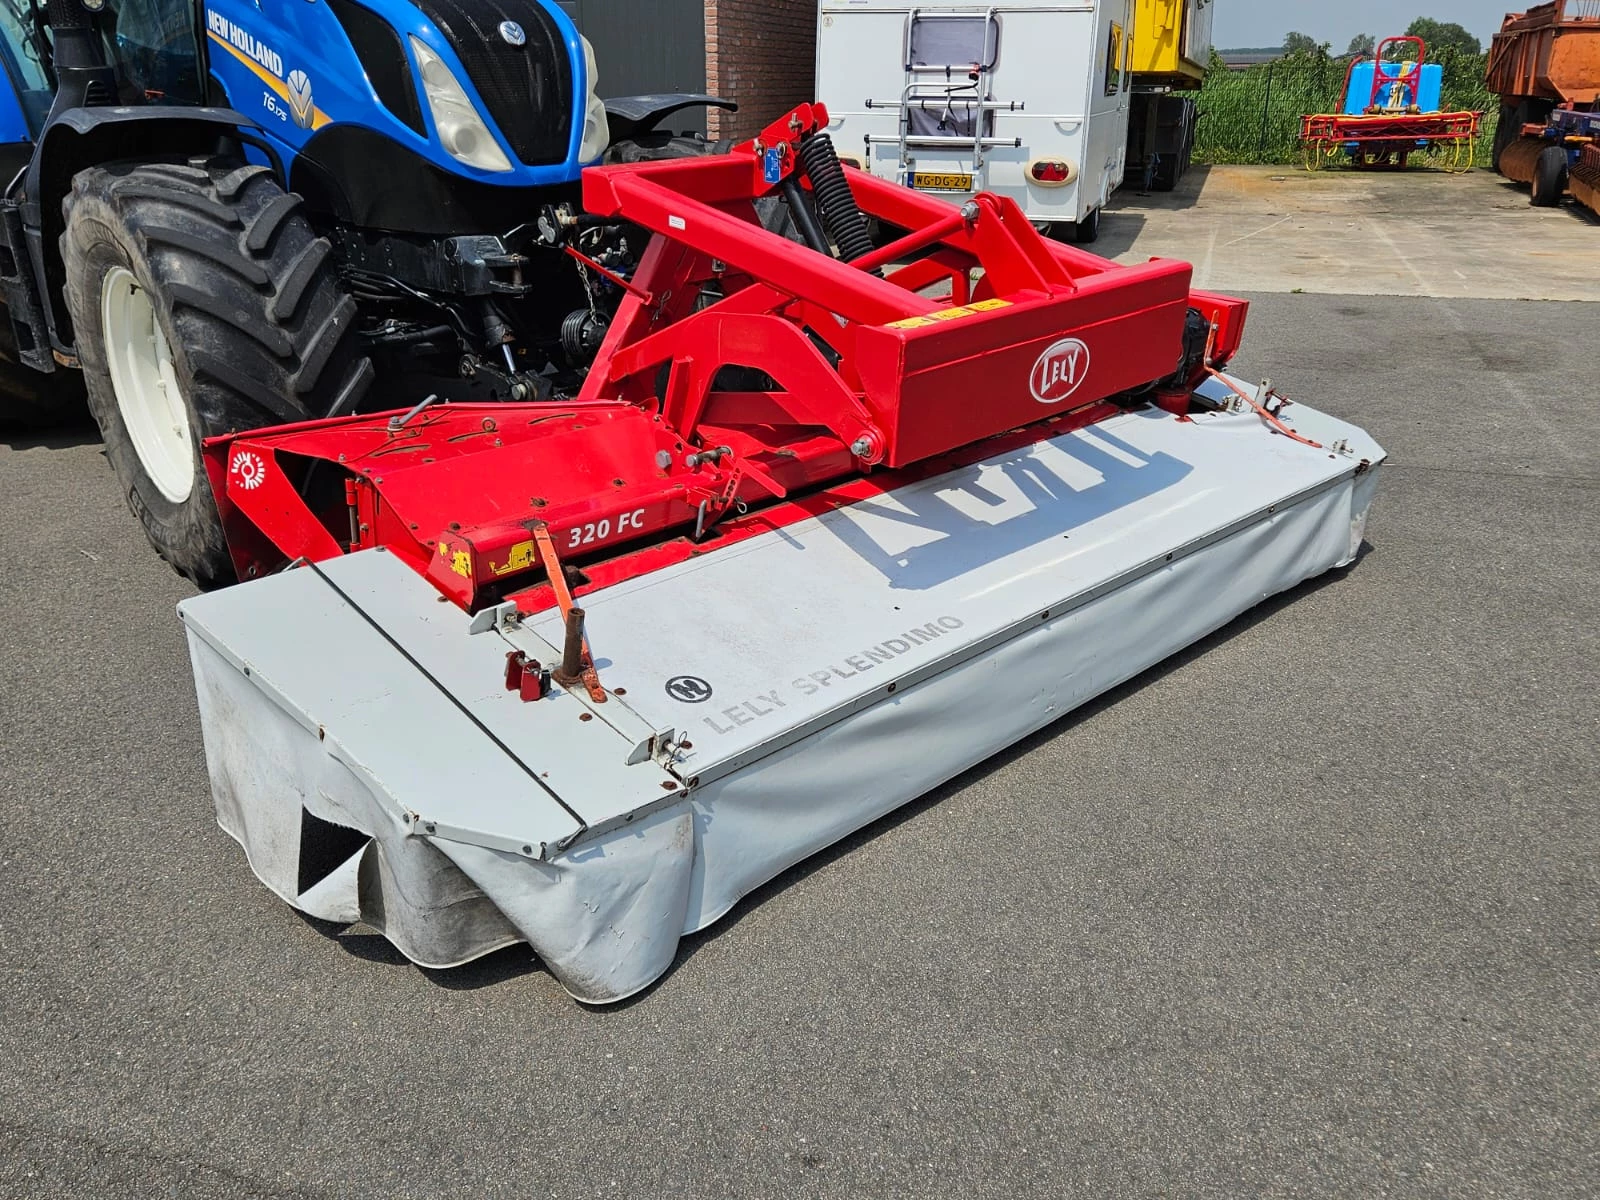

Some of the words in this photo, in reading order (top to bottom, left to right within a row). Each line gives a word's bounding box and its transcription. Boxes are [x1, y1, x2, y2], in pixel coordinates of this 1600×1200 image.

[208, 8, 229, 40] NEW
[229, 22, 283, 78] HOLLAND
[916, 175, 968, 187] WG-DG-29
[1041, 347, 1080, 396] LELY
[568, 519, 610, 548] 320
[617, 508, 645, 534] FC
[703, 689, 787, 735] LELY
[791, 615, 965, 695] SPLENDIMO
